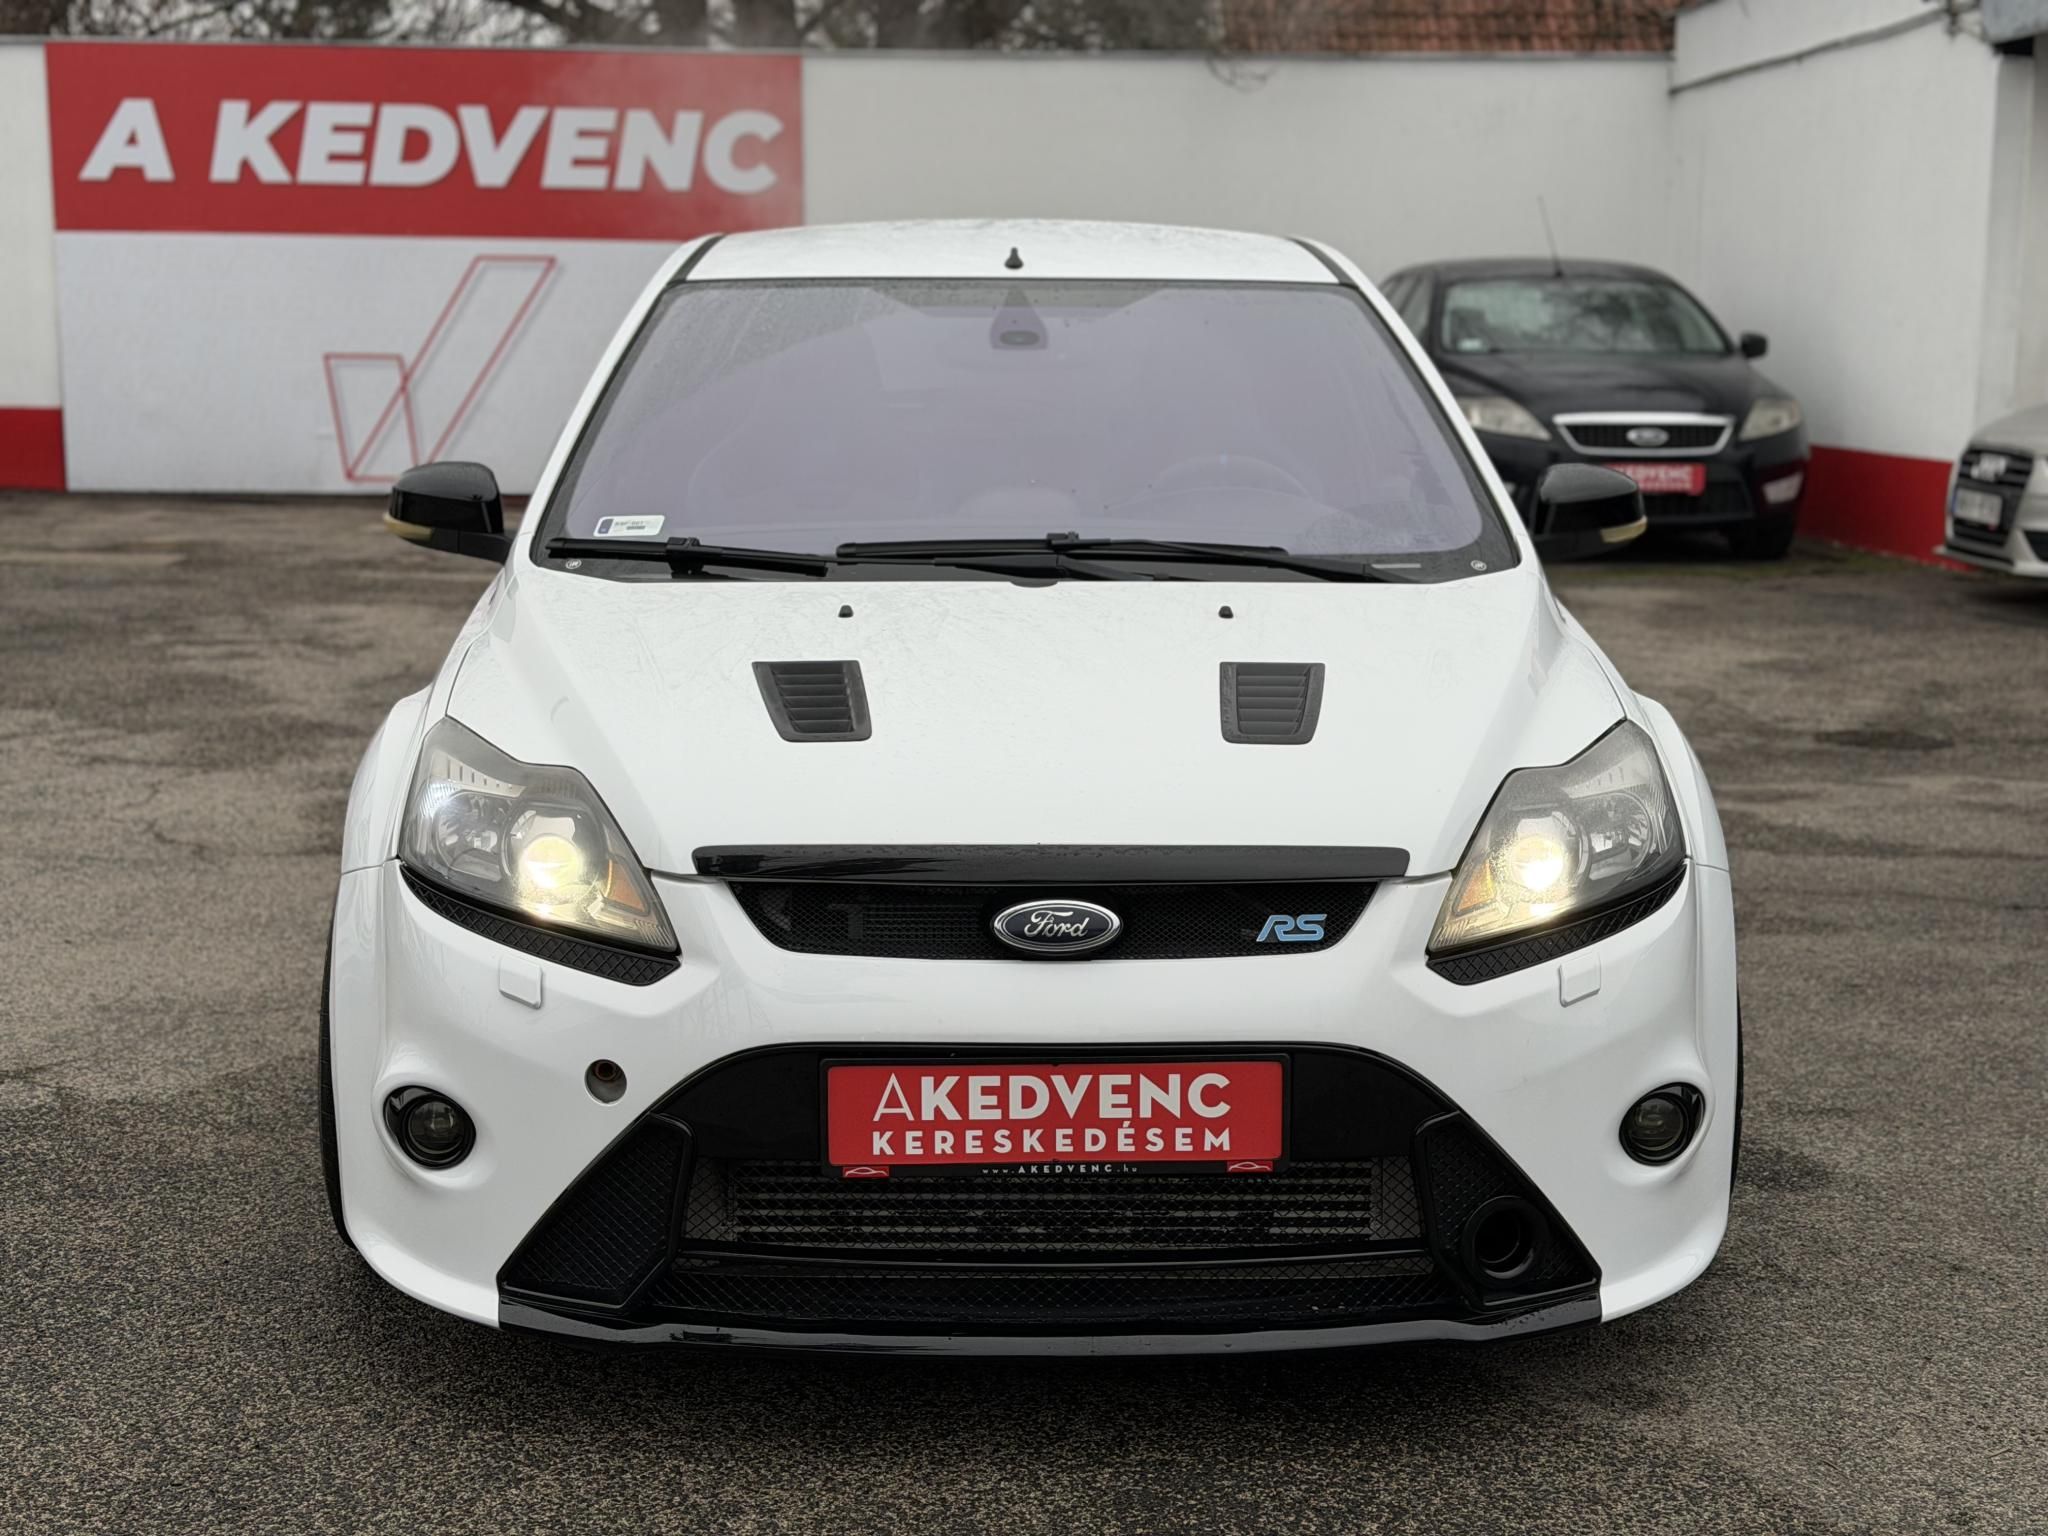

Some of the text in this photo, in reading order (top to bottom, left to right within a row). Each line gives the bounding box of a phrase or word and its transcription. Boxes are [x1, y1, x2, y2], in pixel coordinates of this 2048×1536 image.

[79, 98, 785, 194] A KEDVENC
[1024, 909, 1090, 939] Ford
[1256, 914, 1328, 943] RS
[873, 1121, 1231, 1156] KERESKEDÉSEM
[982, 1164, 1138, 1174] www.AKEDVENC.hu
